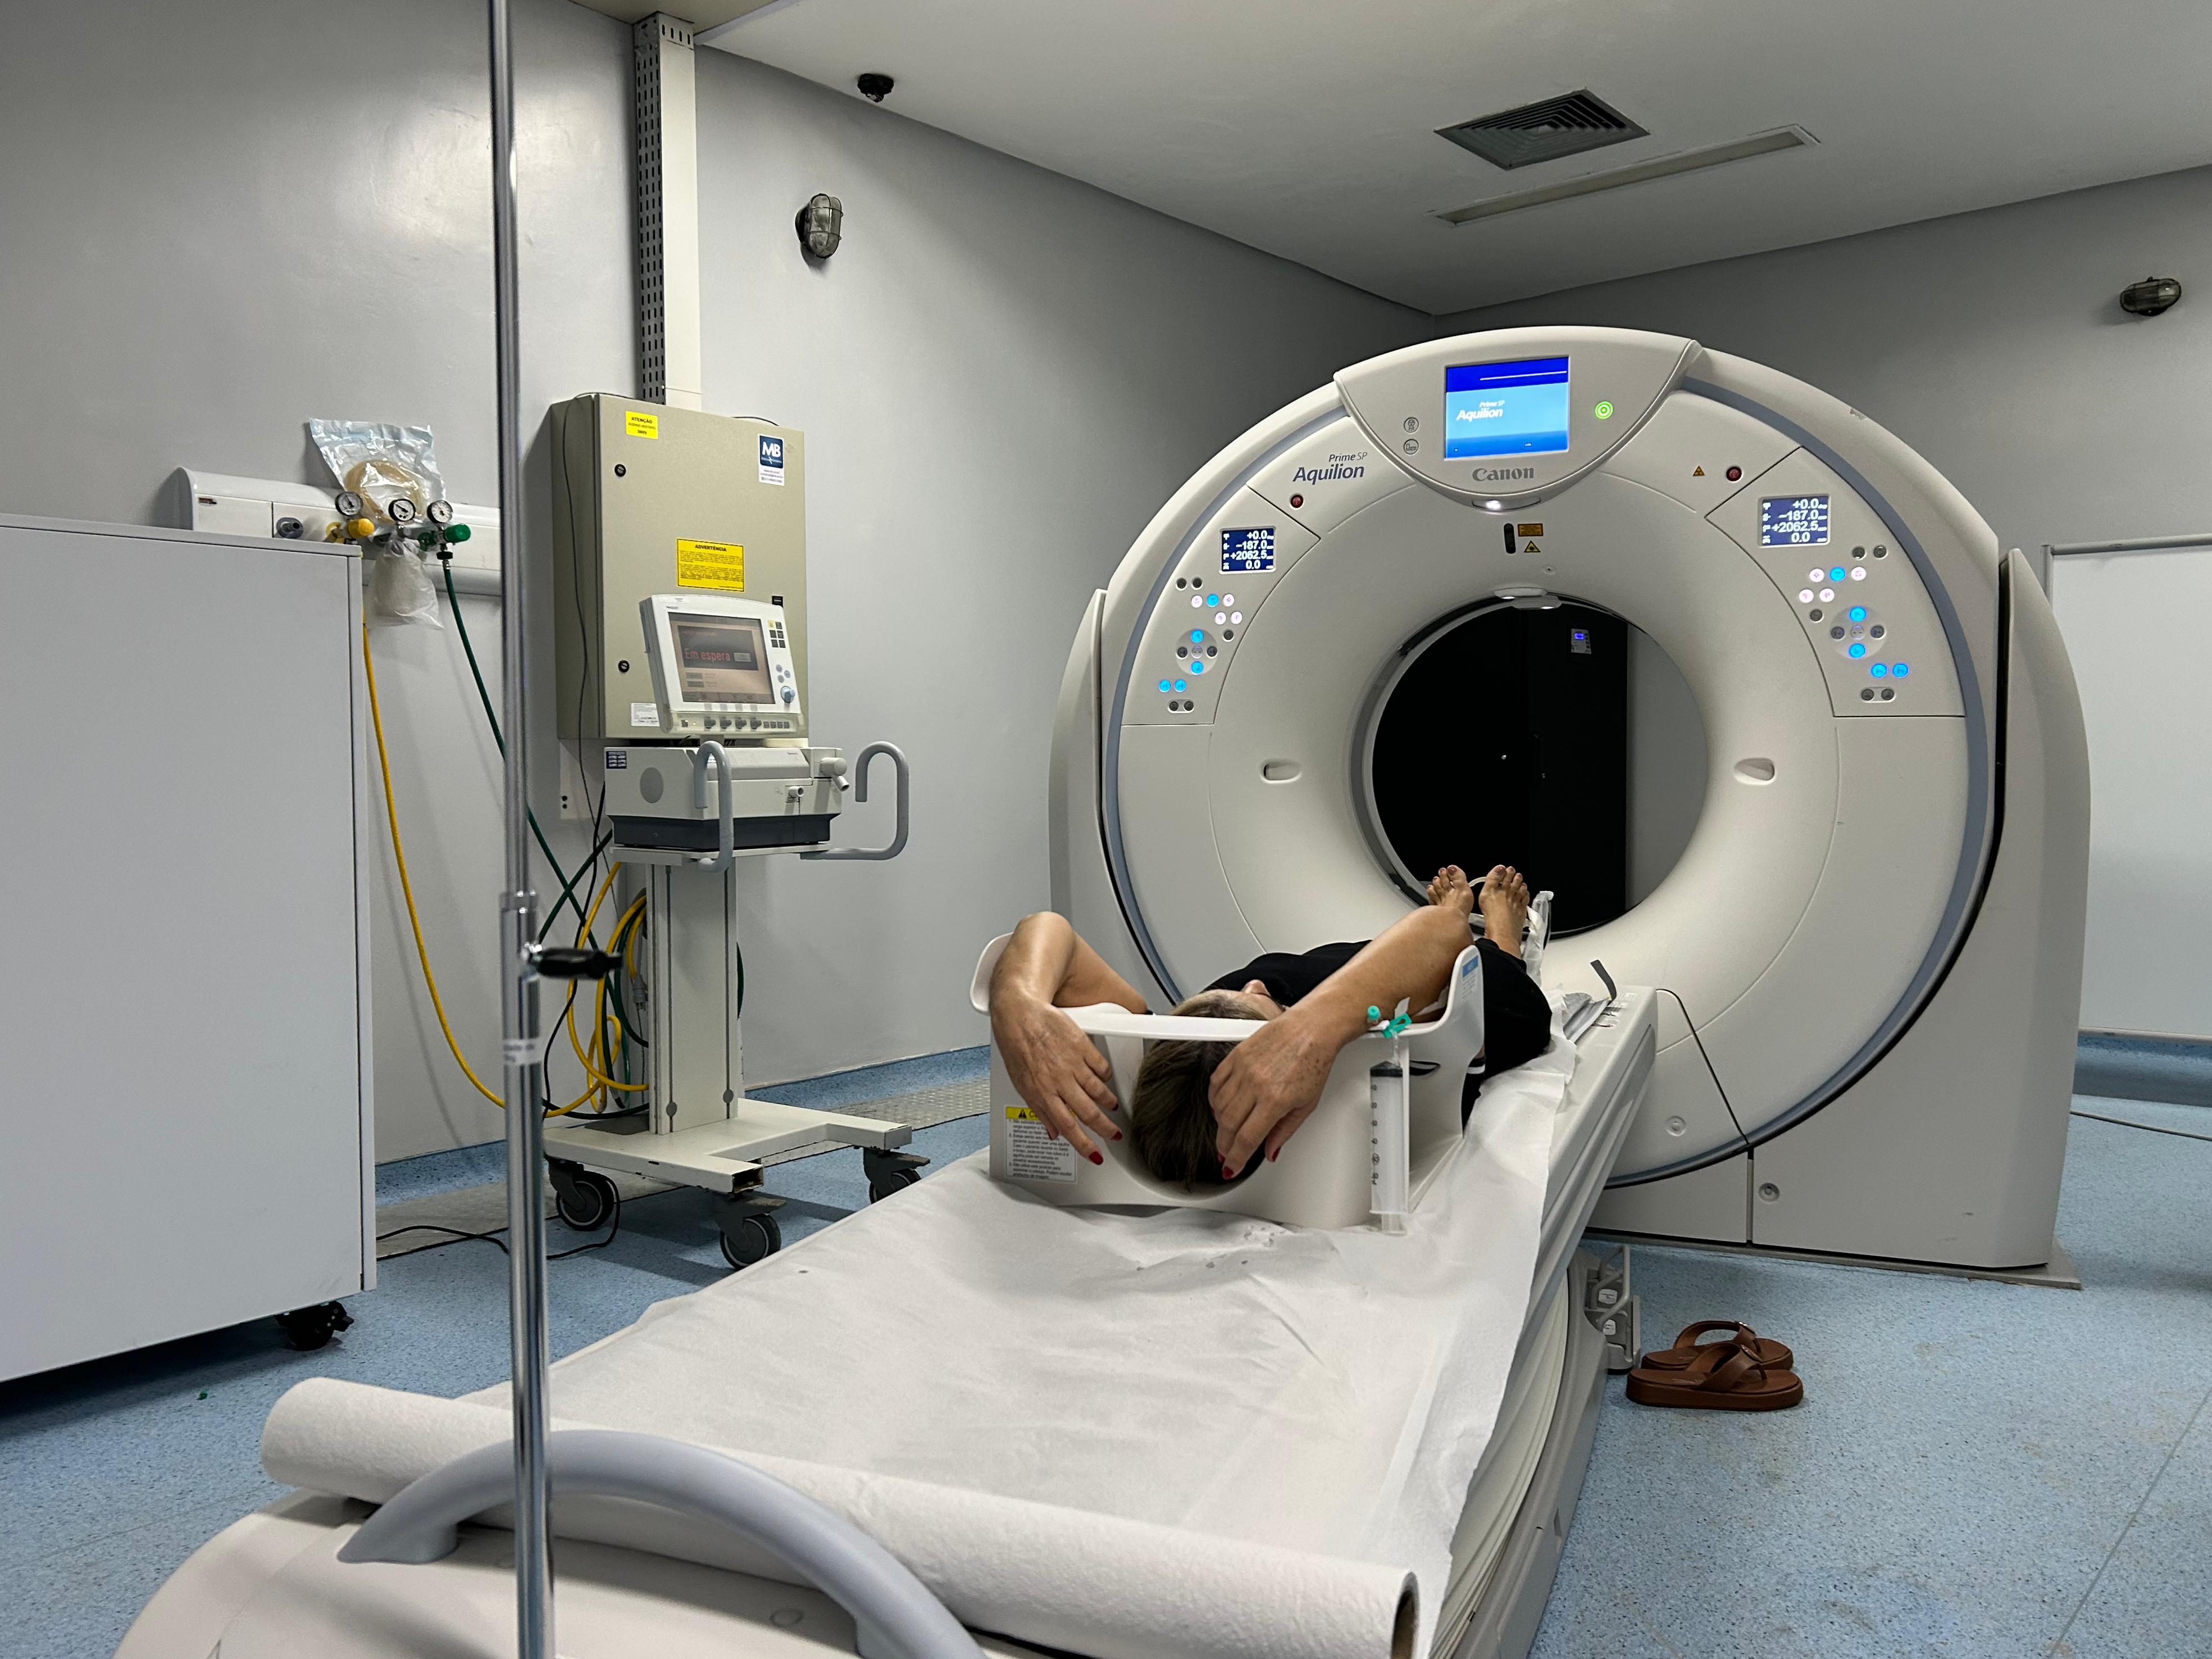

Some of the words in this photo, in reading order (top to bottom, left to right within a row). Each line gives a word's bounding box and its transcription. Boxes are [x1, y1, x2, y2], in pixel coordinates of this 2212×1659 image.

[1456, 407, 1504, 422] Aquilion
[762, 441, 781, 458] MB
[1328, 453, 1356, 462] Prime
[1357, 452, 1368, 461] SP
[1292, 463, 1364, 485] Aquilion
[1472, 467, 1534, 481] Canon
[1792, 498, 1819, 509] +0.0
[1778, 509, 1819, 521] -187.0
[1771, 520, 1819, 533] +2062.5
[1246, 530, 1268, 540] +0.0
[1791, 531, 1810, 543] 0.0
[1236, 539, 1267, 550] -187.0
[1230, 549, 1267, 560] +2062.5
[1245, 560, 1261, 569] 0.0
[685, 648, 699, 660] Em
[701, 652, 731, 662] espera
